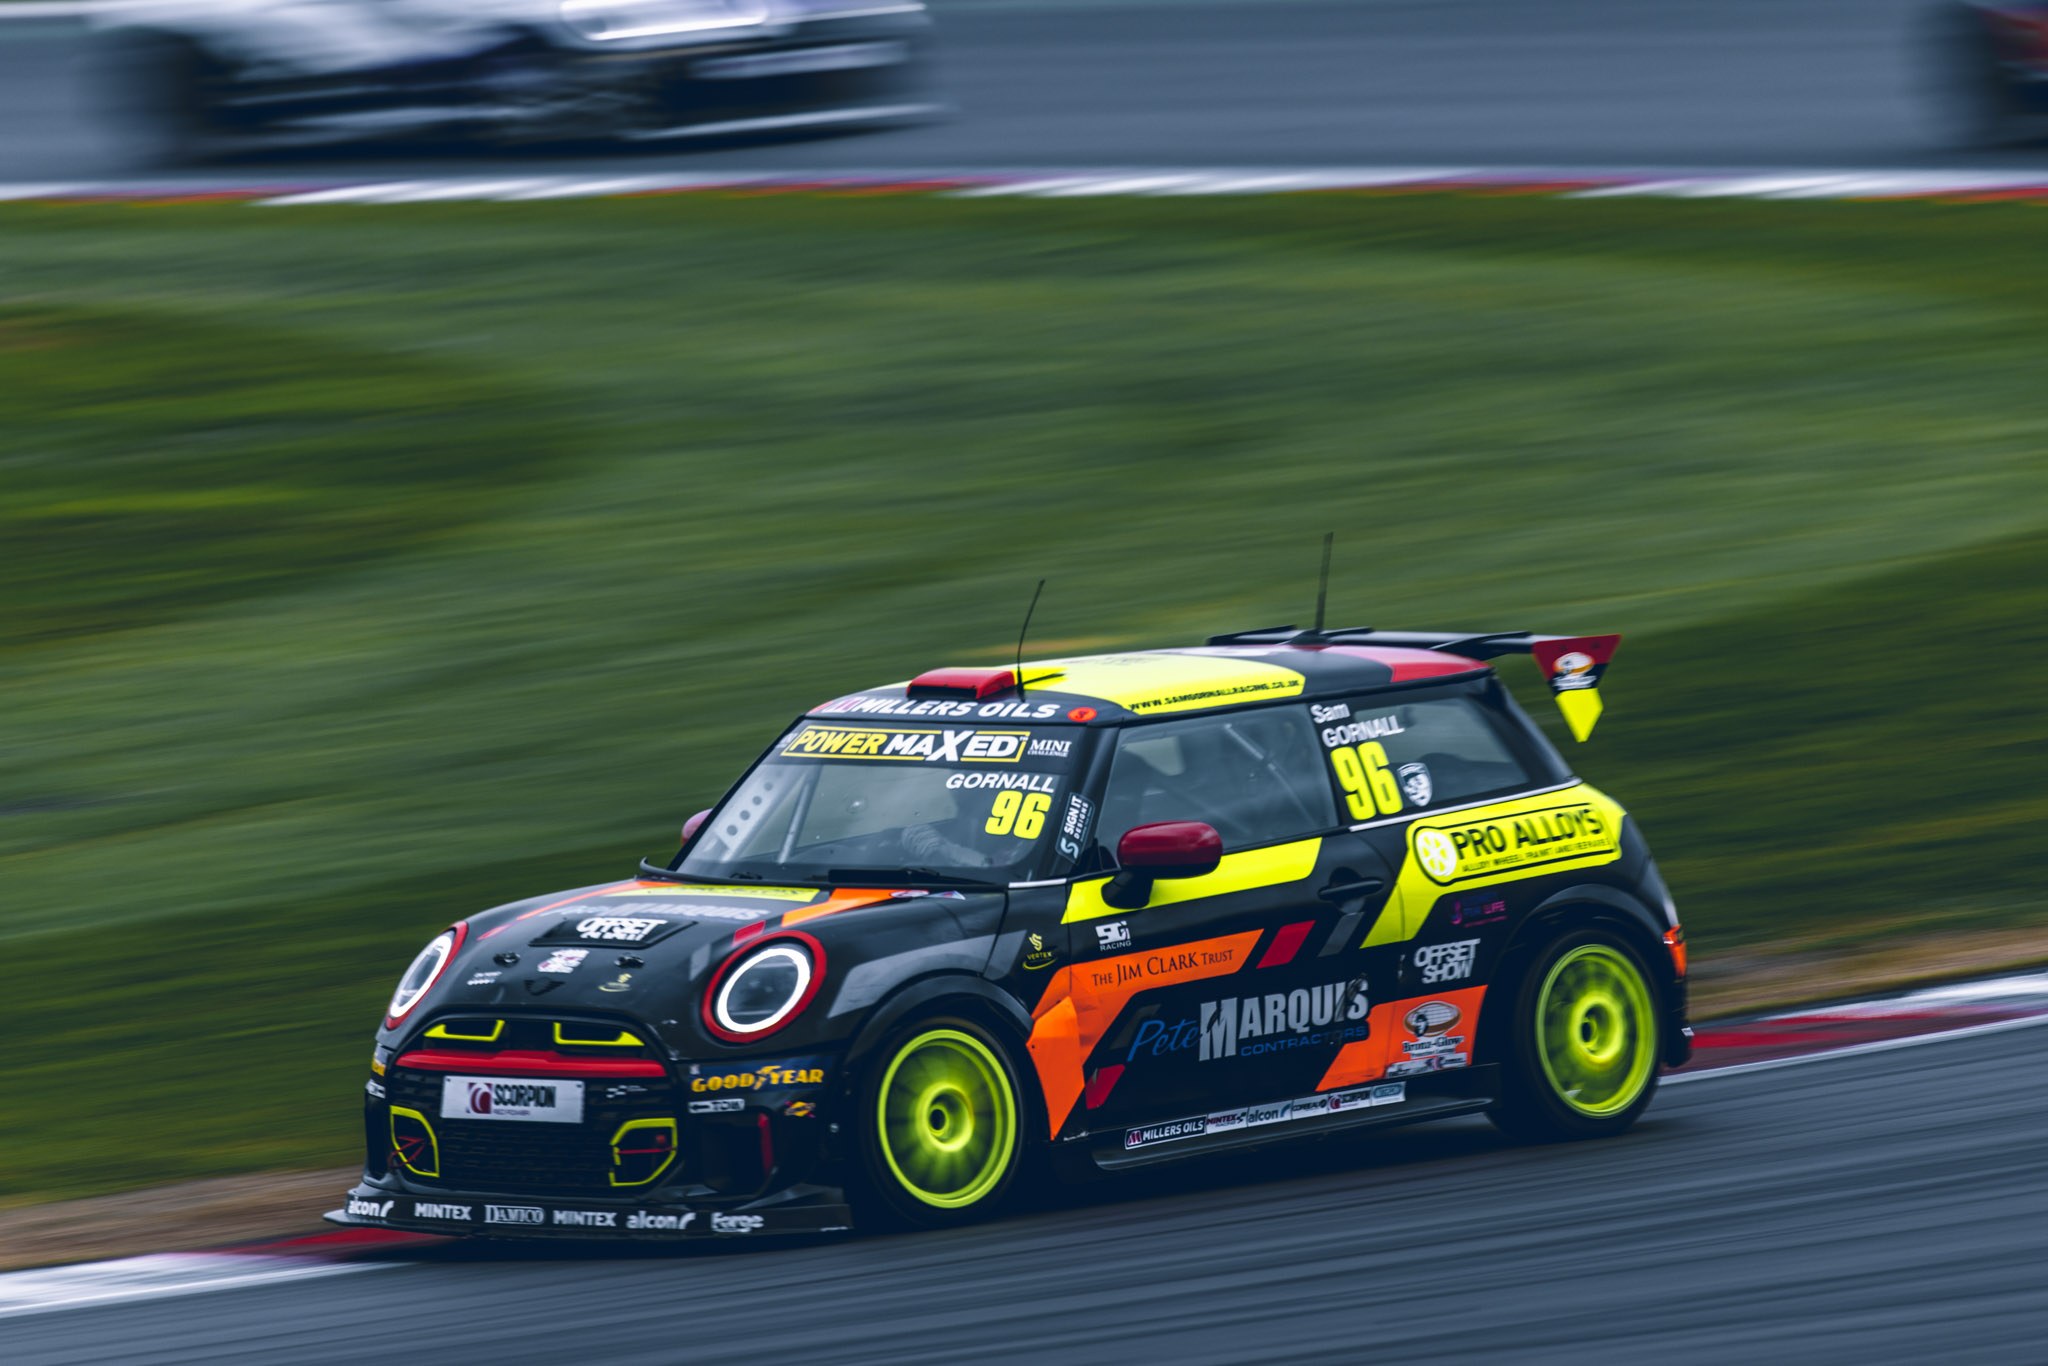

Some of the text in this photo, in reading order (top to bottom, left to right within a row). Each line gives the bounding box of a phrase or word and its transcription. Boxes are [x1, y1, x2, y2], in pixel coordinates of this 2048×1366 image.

[859, 700, 1061, 718] MILLERS OILS
[1310, 703, 1350, 724] Sam
[1321, 715, 1405, 748] GORNALL
[789, 730, 889, 755] POWER
[882, 729, 1021, 762] MAXED
[1030, 739, 1072, 754] MINI
[945, 773, 1055, 793] GORNALL
[1330, 740, 1403, 820] 96
[985, 790, 1052, 840] 96
[1064, 795, 1082, 835] SIGN IT
[1073, 802, 1089, 840] DESIGNS
[1449, 808, 1604, 861] PRO ALLOYS
[576, 917, 669, 933] OFFSET
[1026, 951, 1052, 961] VERTEX
[1100, 940, 1132, 952] RACING
[1414, 938, 1481, 968] OFFSET
[1117, 963, 1143, 986] JIM
[1146, 952, 1197, 976] CLARK
[1200, 949, 1236, 965] TRUST
[1421, 959, 1474, 984] SHOW
[1127, 978, 1369, 1062] Pete MARQUIS
[493, 1083, 557, 1109] SCORPION
[1248, 1107, 1279, 1124] alcon
[1142, 1120, 1204, 1141] MILLERS OILS
[348, 1197, 382, 1218] alcon
[414, 1202, 472, 1220] MINTEX
[553, 1209, 616, 1227] MINTEX
[625, 1210, 679, 1229] alcon
[711, 1211, 764, 1232] Forge
